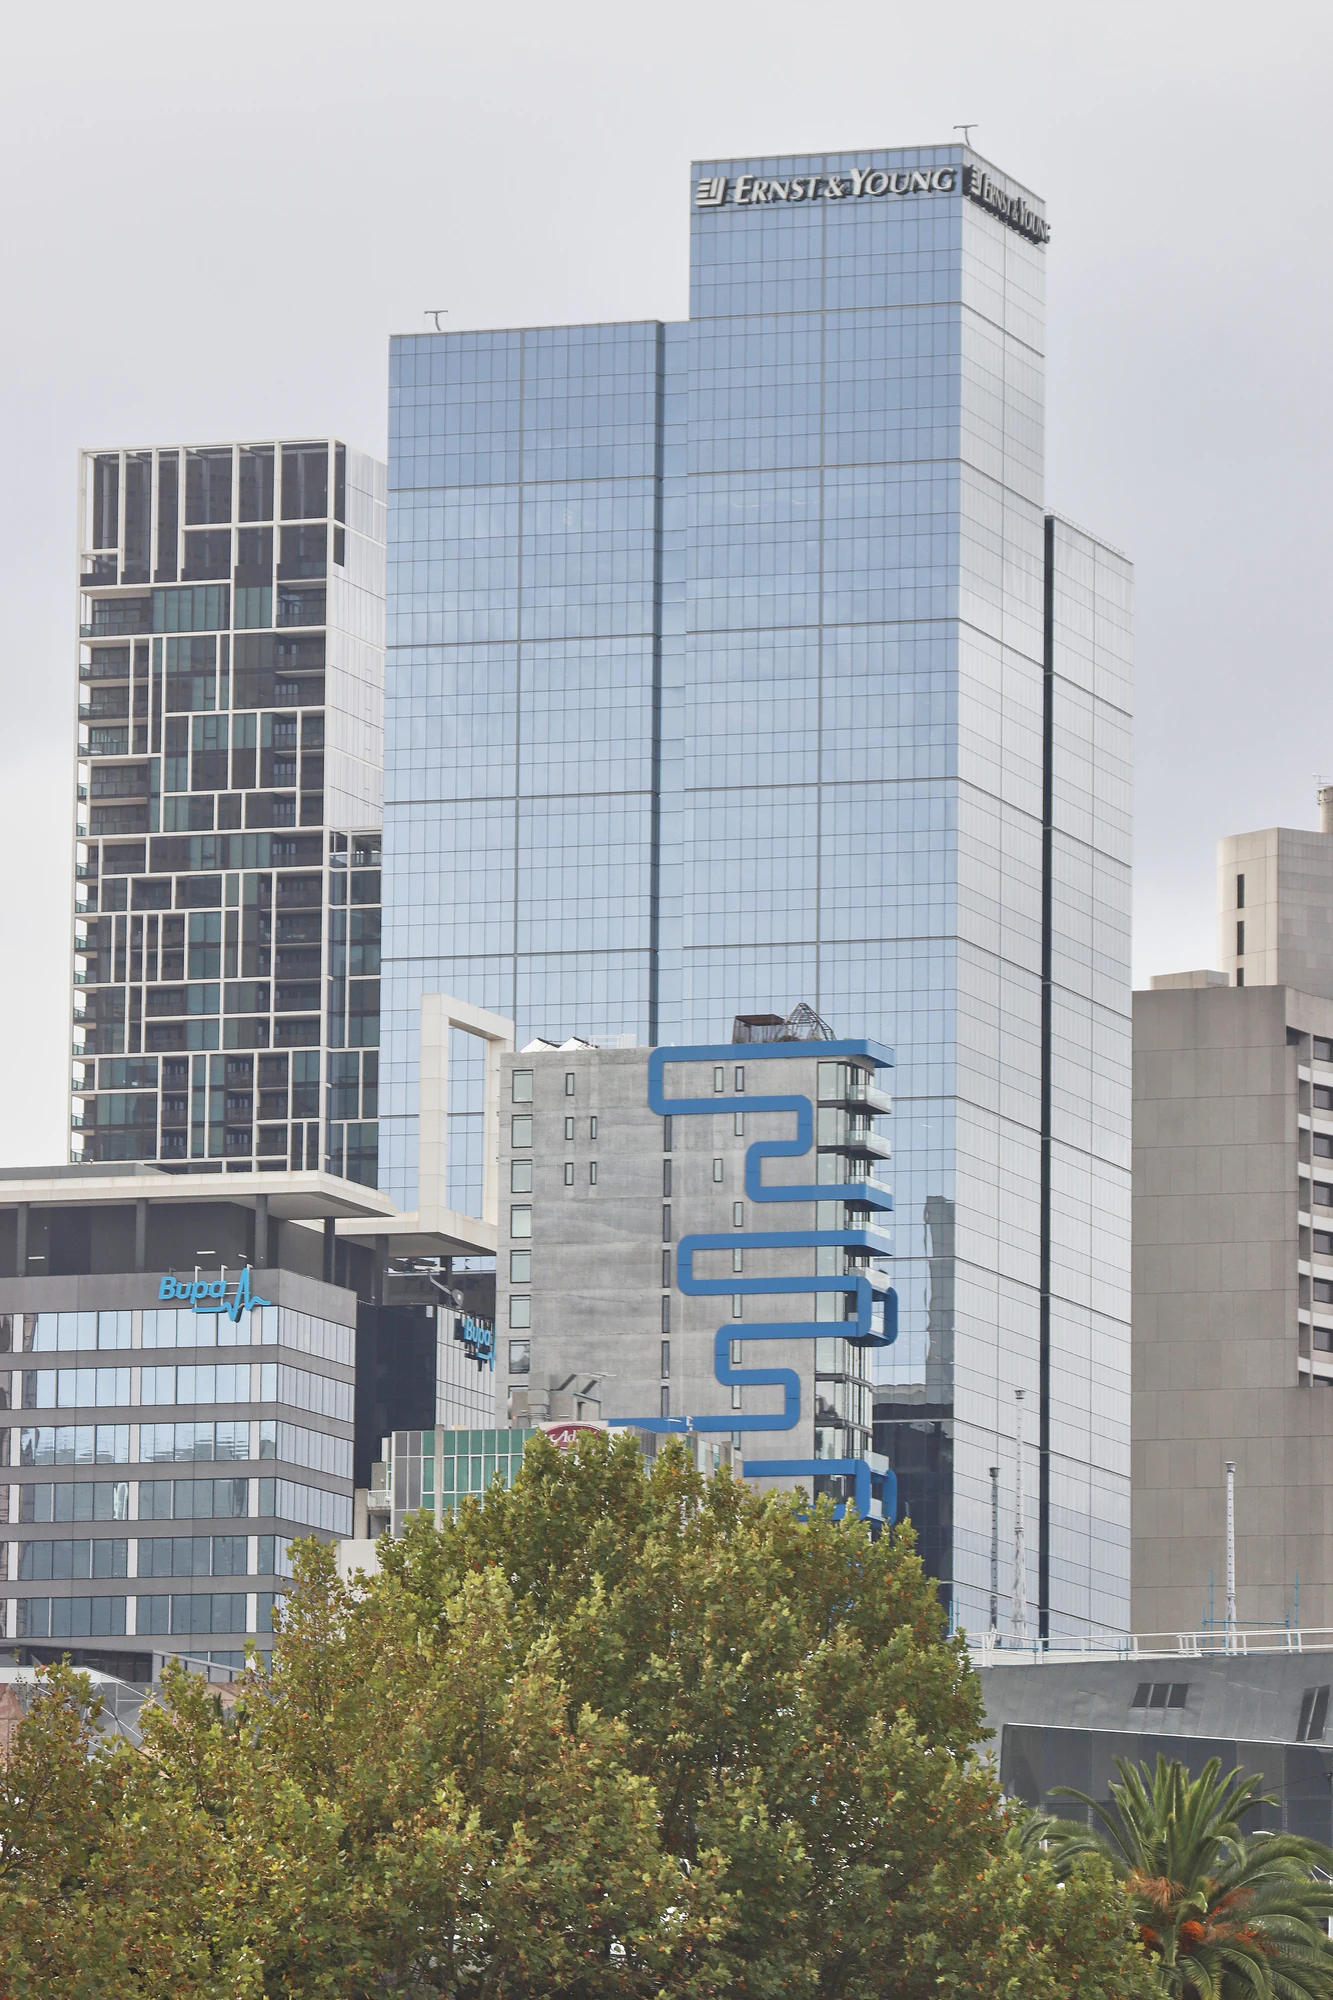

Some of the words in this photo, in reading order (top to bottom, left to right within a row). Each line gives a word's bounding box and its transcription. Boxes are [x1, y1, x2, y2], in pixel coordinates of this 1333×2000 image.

[734, 174, 822, 203] ERNST
[824, 175, 846, 197] &
[850, 166, 955, 195] YOUNG
[158, 1276, 227, 1305] Bupa
[464, 1317, 491, 1349] Bupa
